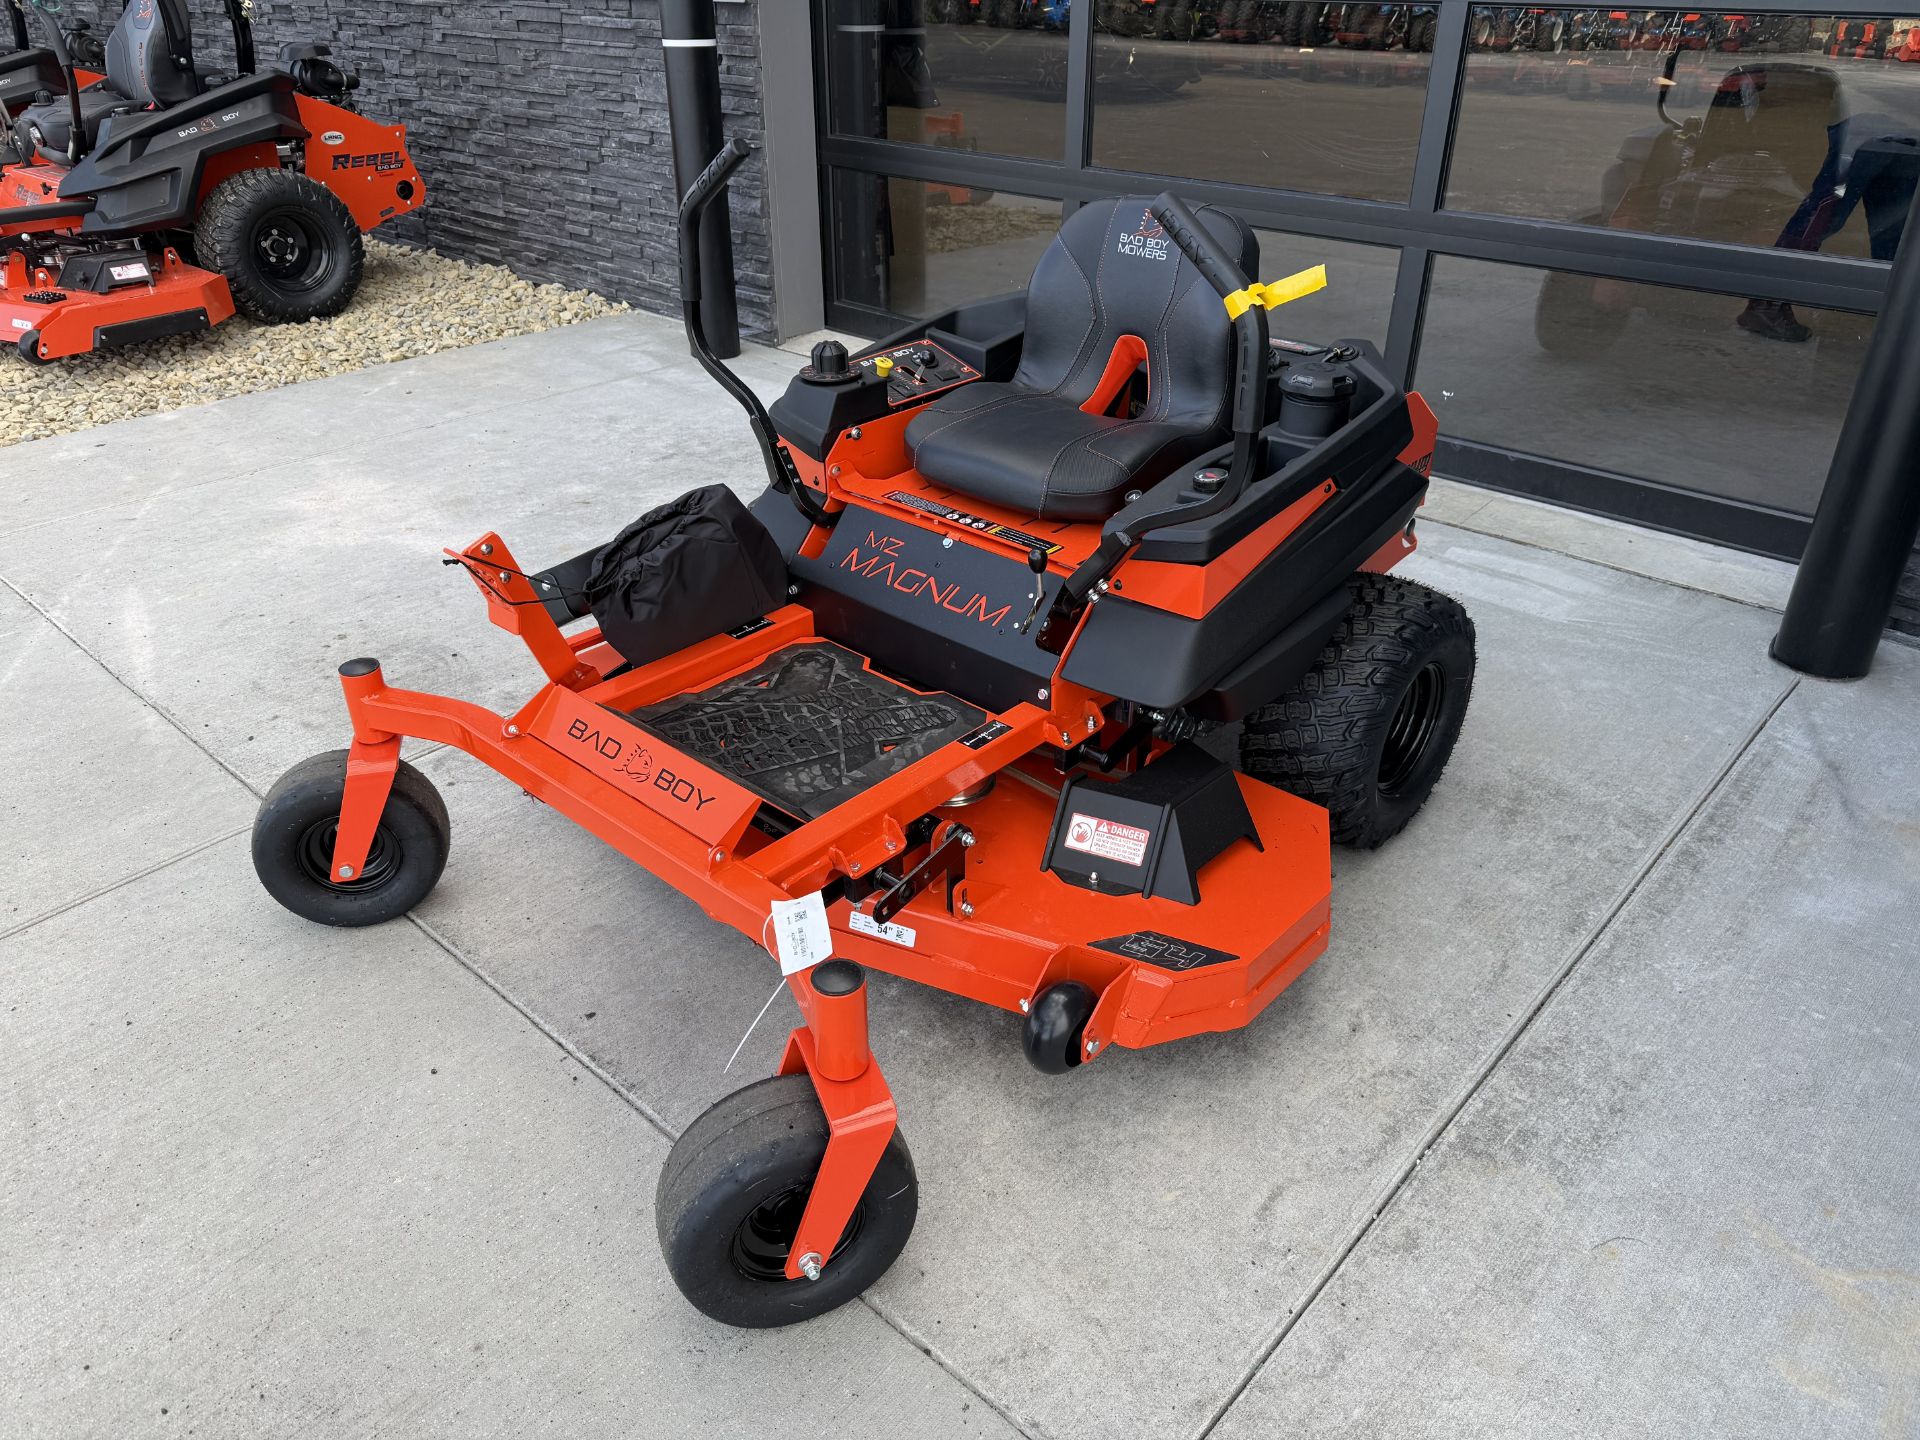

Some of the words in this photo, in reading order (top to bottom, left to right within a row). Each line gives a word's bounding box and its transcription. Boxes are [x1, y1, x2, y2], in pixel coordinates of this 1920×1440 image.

[178, 126, 198, 137] BAD
[222, 111, 239, 122] BOY
[331, 151, 405, 170] REBEL
[1120, 233, 1144, 246] BAD
[1146, 238, 1170, 250] BOY
[1117, 243, 1168, 261] MOWERS
[893, 347, 915, 358] BOY
[864, 530, 905, 557] MZ
[839, 547, 1012, 627] MAGNUM
[567, 718, 623, 760] BAD
[653, 767, 717, 811] BOY
[1110, 825, 1146, 842] DANGER
